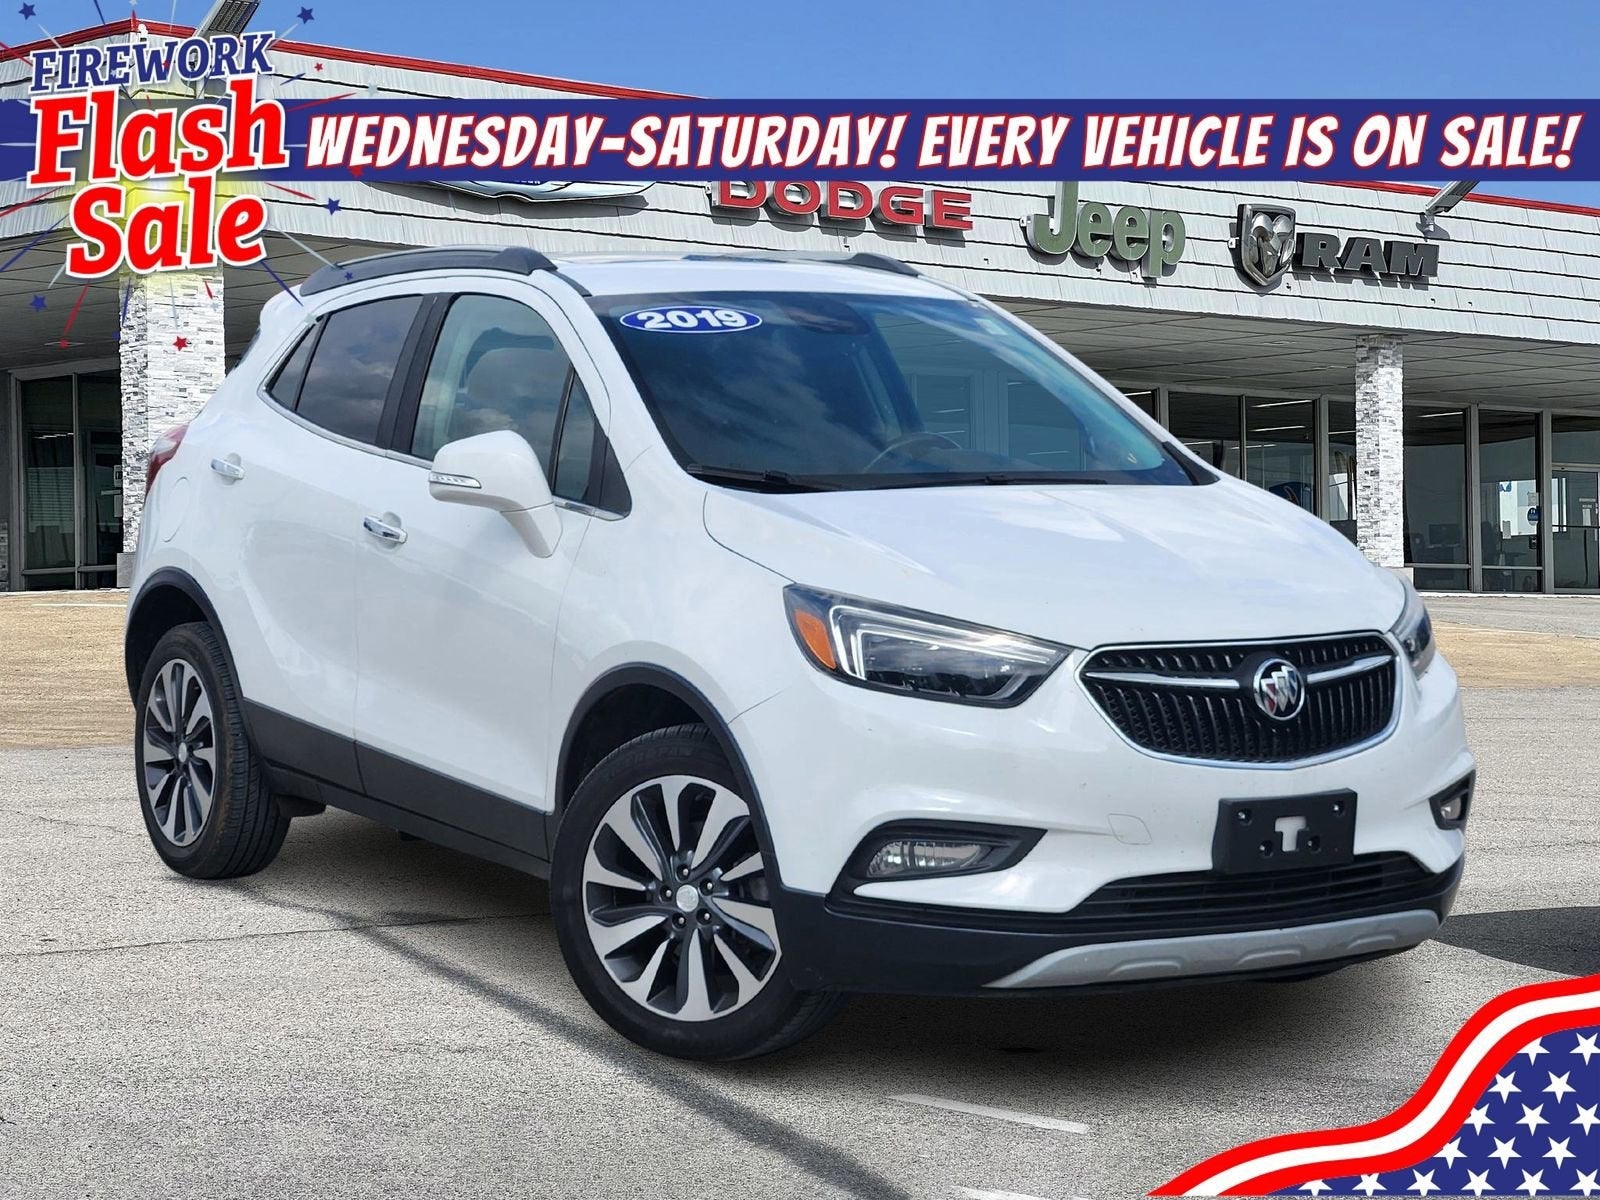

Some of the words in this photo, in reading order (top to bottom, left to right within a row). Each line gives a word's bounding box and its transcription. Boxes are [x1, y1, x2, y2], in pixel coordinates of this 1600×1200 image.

[718, 181, 973, 230] DODGE
[1030, 181, 1186, 278] Jeep
[1301, 232, 1440, 278] RAM
[637, 308, 748, 329] 2019
